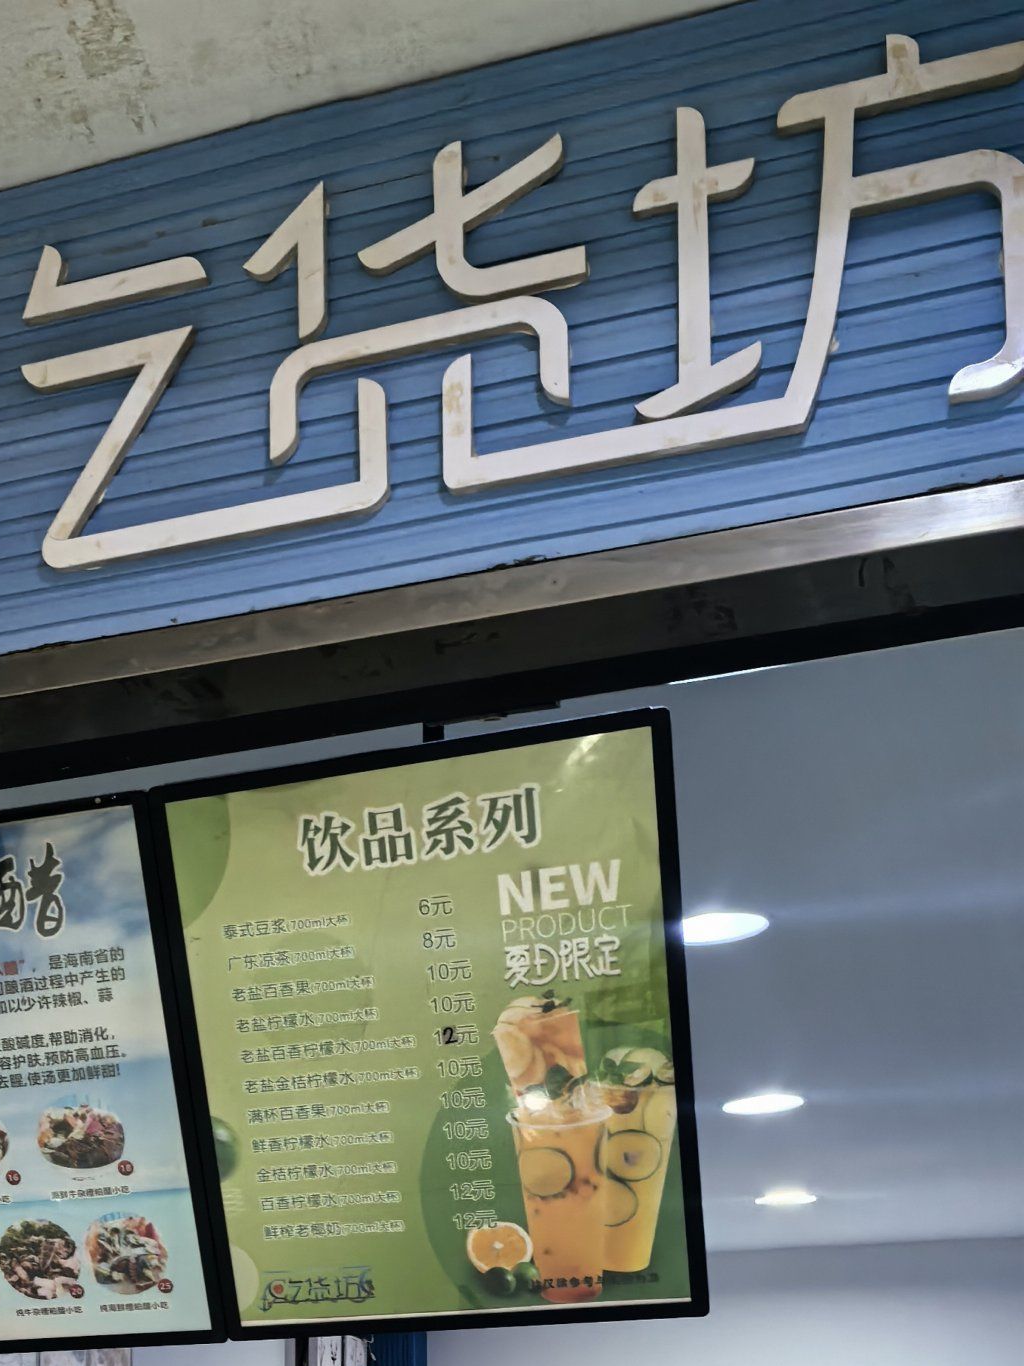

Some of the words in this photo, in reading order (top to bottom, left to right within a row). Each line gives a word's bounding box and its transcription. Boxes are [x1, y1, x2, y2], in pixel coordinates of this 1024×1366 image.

[298, 783, 541, 877] 饮品系列
[497, 859, 621, 916] NEW
[418, 894, 453, 916] 6元
[501, 904, 632, 943] PRODUCT
[422, 928, 456, 949] 8元
[427, 960, 472, 981] 10元
[504, 934, 622, 989] 夏日限定
[430, 991, 475, 1013] 10元
[437, 1056, 482, 1078] 10元
[440, 1087, 485, 1109] 10元
[443, 1118, 488, 1140] 10元
[446, 1150, 492, 1171] 10元
[449, 1180, 495, 1202] 12元
[452, 1210, 498, 1230] 12元
